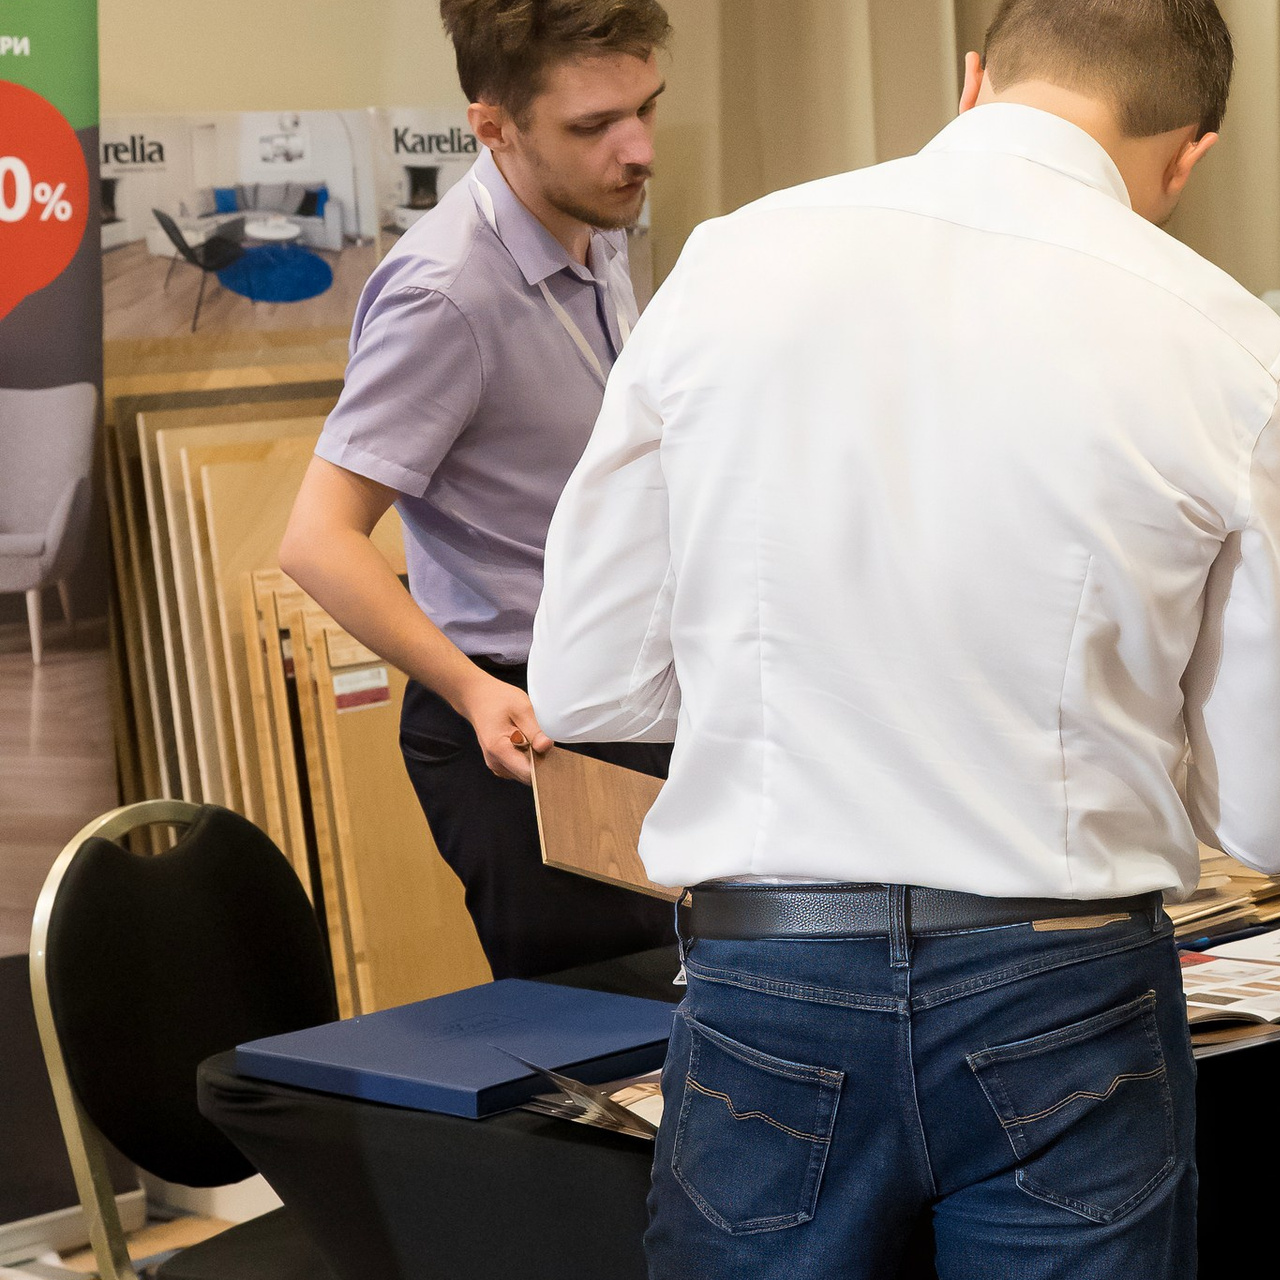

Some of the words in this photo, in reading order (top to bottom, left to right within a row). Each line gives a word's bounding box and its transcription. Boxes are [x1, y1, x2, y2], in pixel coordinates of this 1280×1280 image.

[0, 36, 30, 56] РИ
[102, 134, 165, 164] relia
[393, 126, 477, 154] Karelia
[0, 155, 73, 222] 0%
